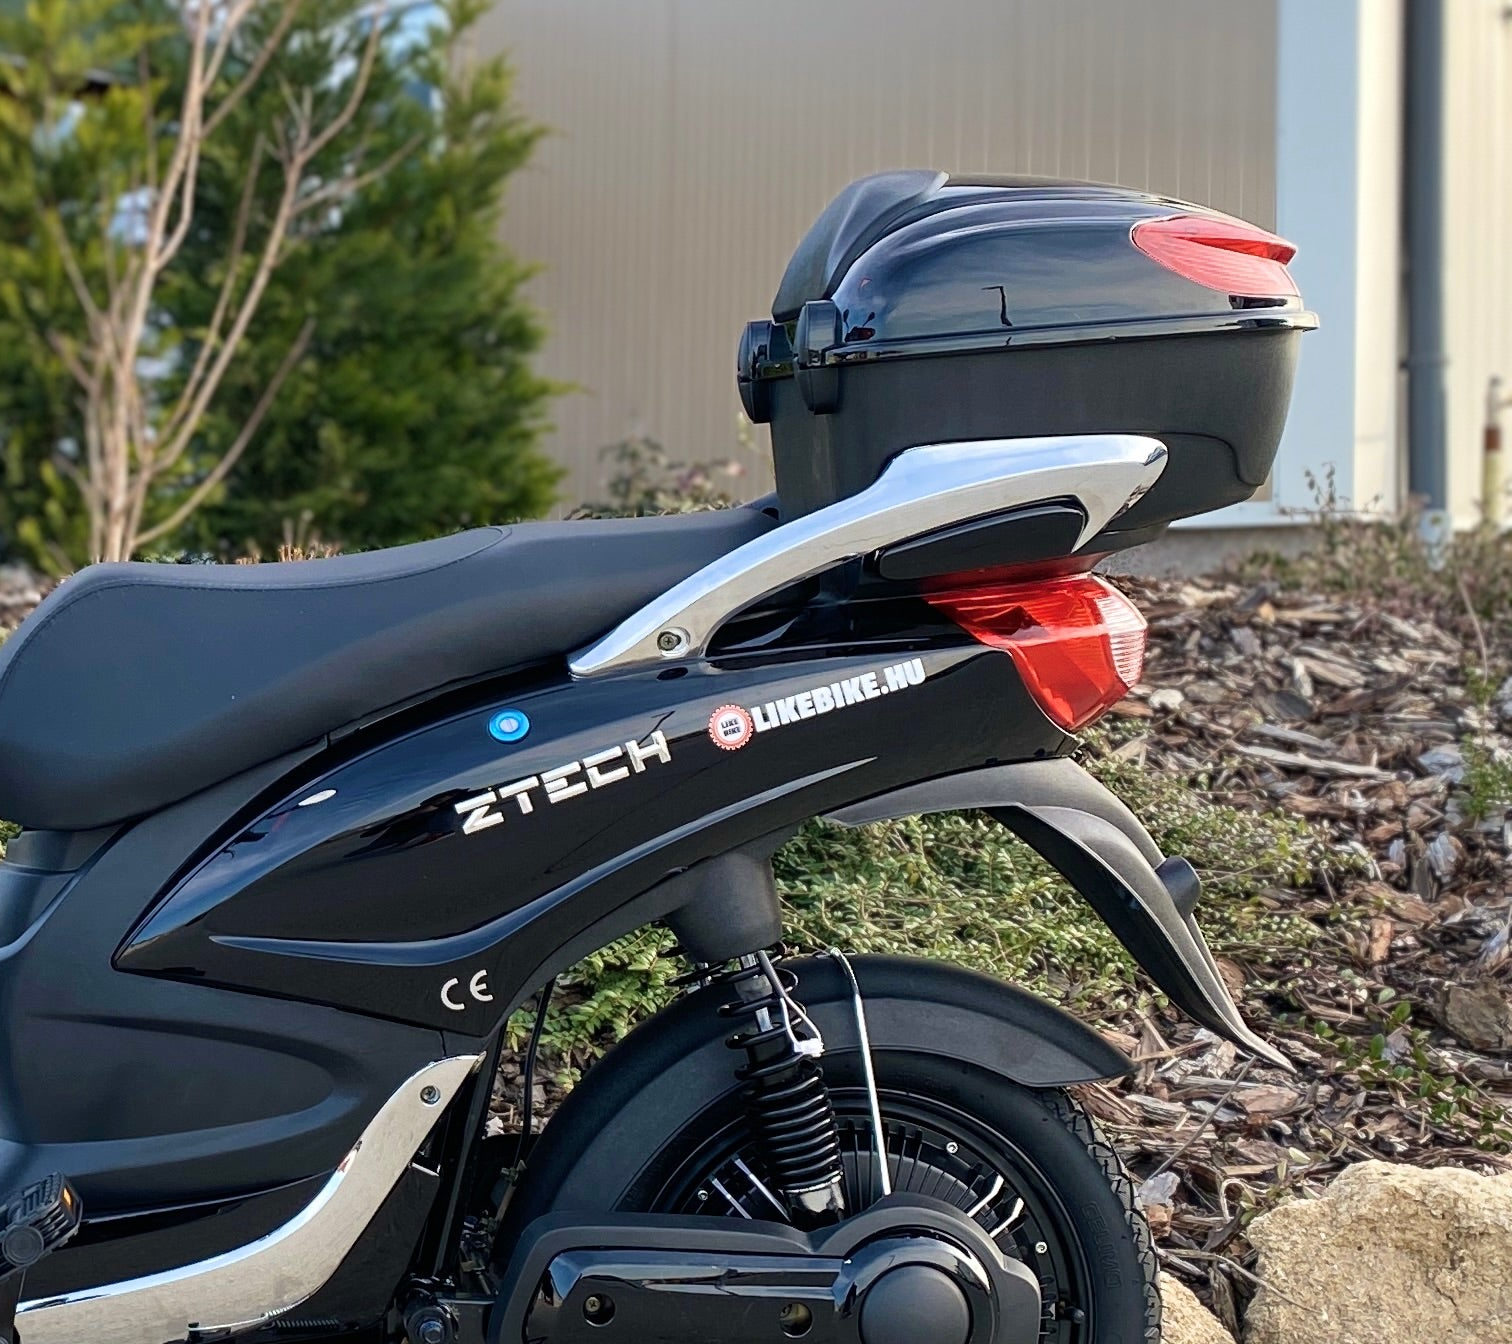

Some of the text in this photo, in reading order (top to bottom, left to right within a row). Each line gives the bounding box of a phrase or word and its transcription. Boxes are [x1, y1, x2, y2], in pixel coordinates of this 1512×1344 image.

[750, 657, 926, 733] LIKEBIKE.HU
[454, 729, 672, 835] ZTECH
[440, 969, 494, 1011] CE
